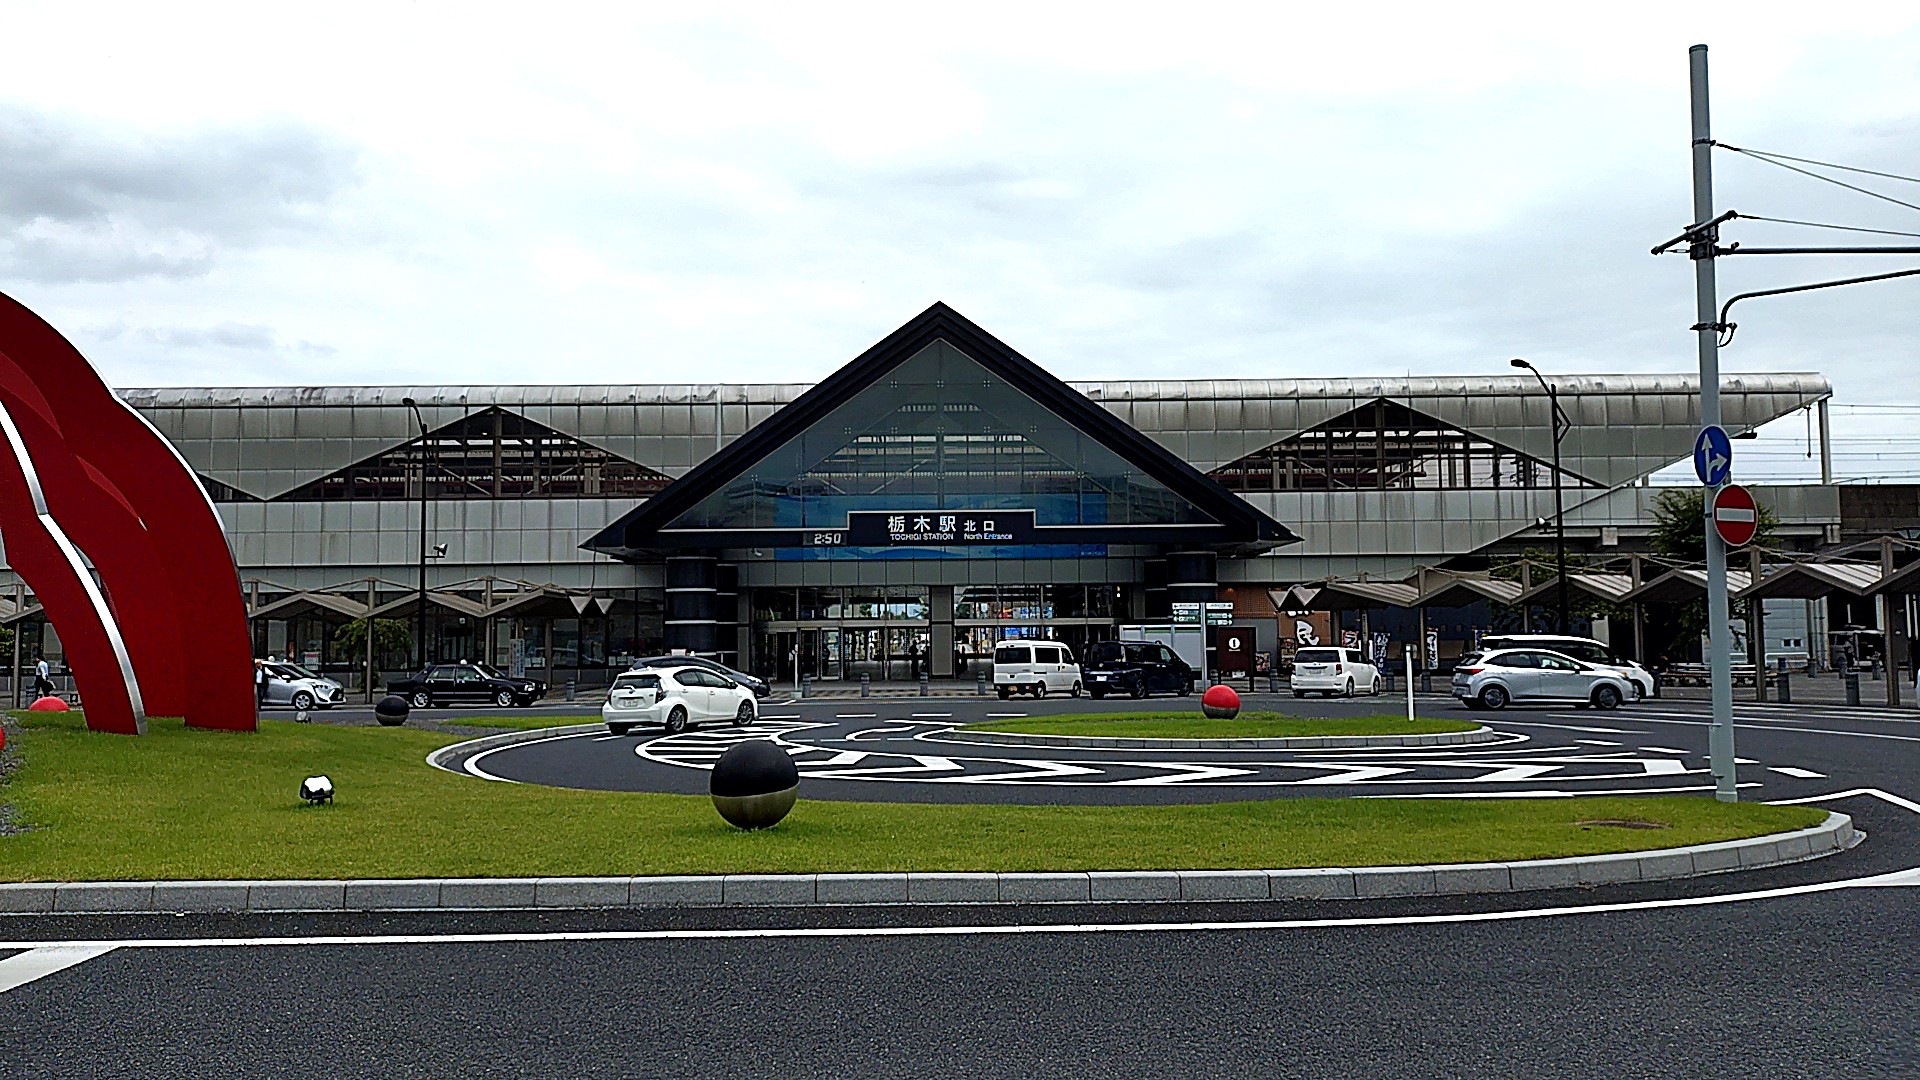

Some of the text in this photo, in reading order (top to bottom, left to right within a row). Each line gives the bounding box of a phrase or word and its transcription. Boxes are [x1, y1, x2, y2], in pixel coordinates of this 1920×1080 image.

[887, 515, 995, 533] 栃木駅 北口
[814, 533, 842, 544] 2:50
[889, 533, 922, 541] TOCHIGI
[922, 533, 954, 541] STATION
